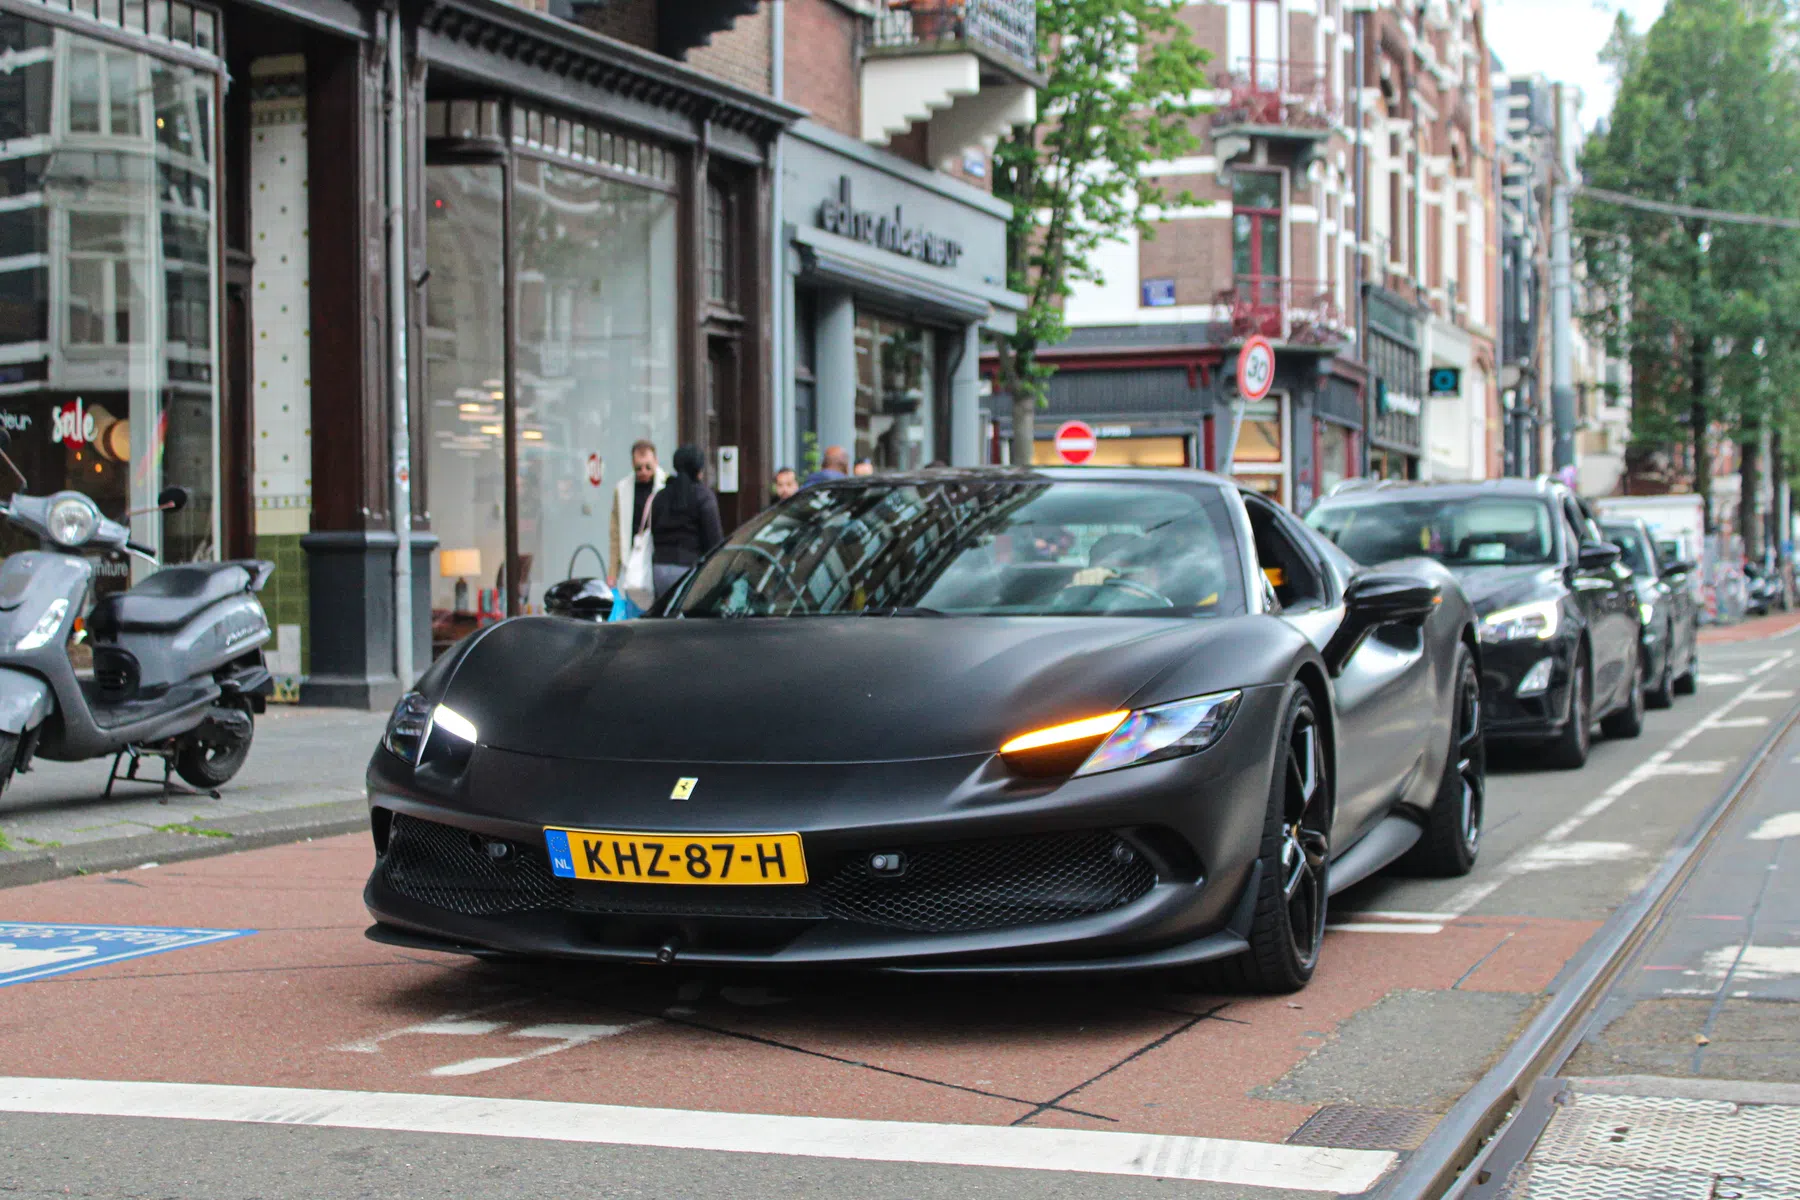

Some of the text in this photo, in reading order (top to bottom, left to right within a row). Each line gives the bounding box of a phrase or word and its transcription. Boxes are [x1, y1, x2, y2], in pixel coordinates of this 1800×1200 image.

[1247, 355, 1268, 383] 30
[554, 859, 572, 871] NL
[583, 839, 787, 879] KHZ-87-H
